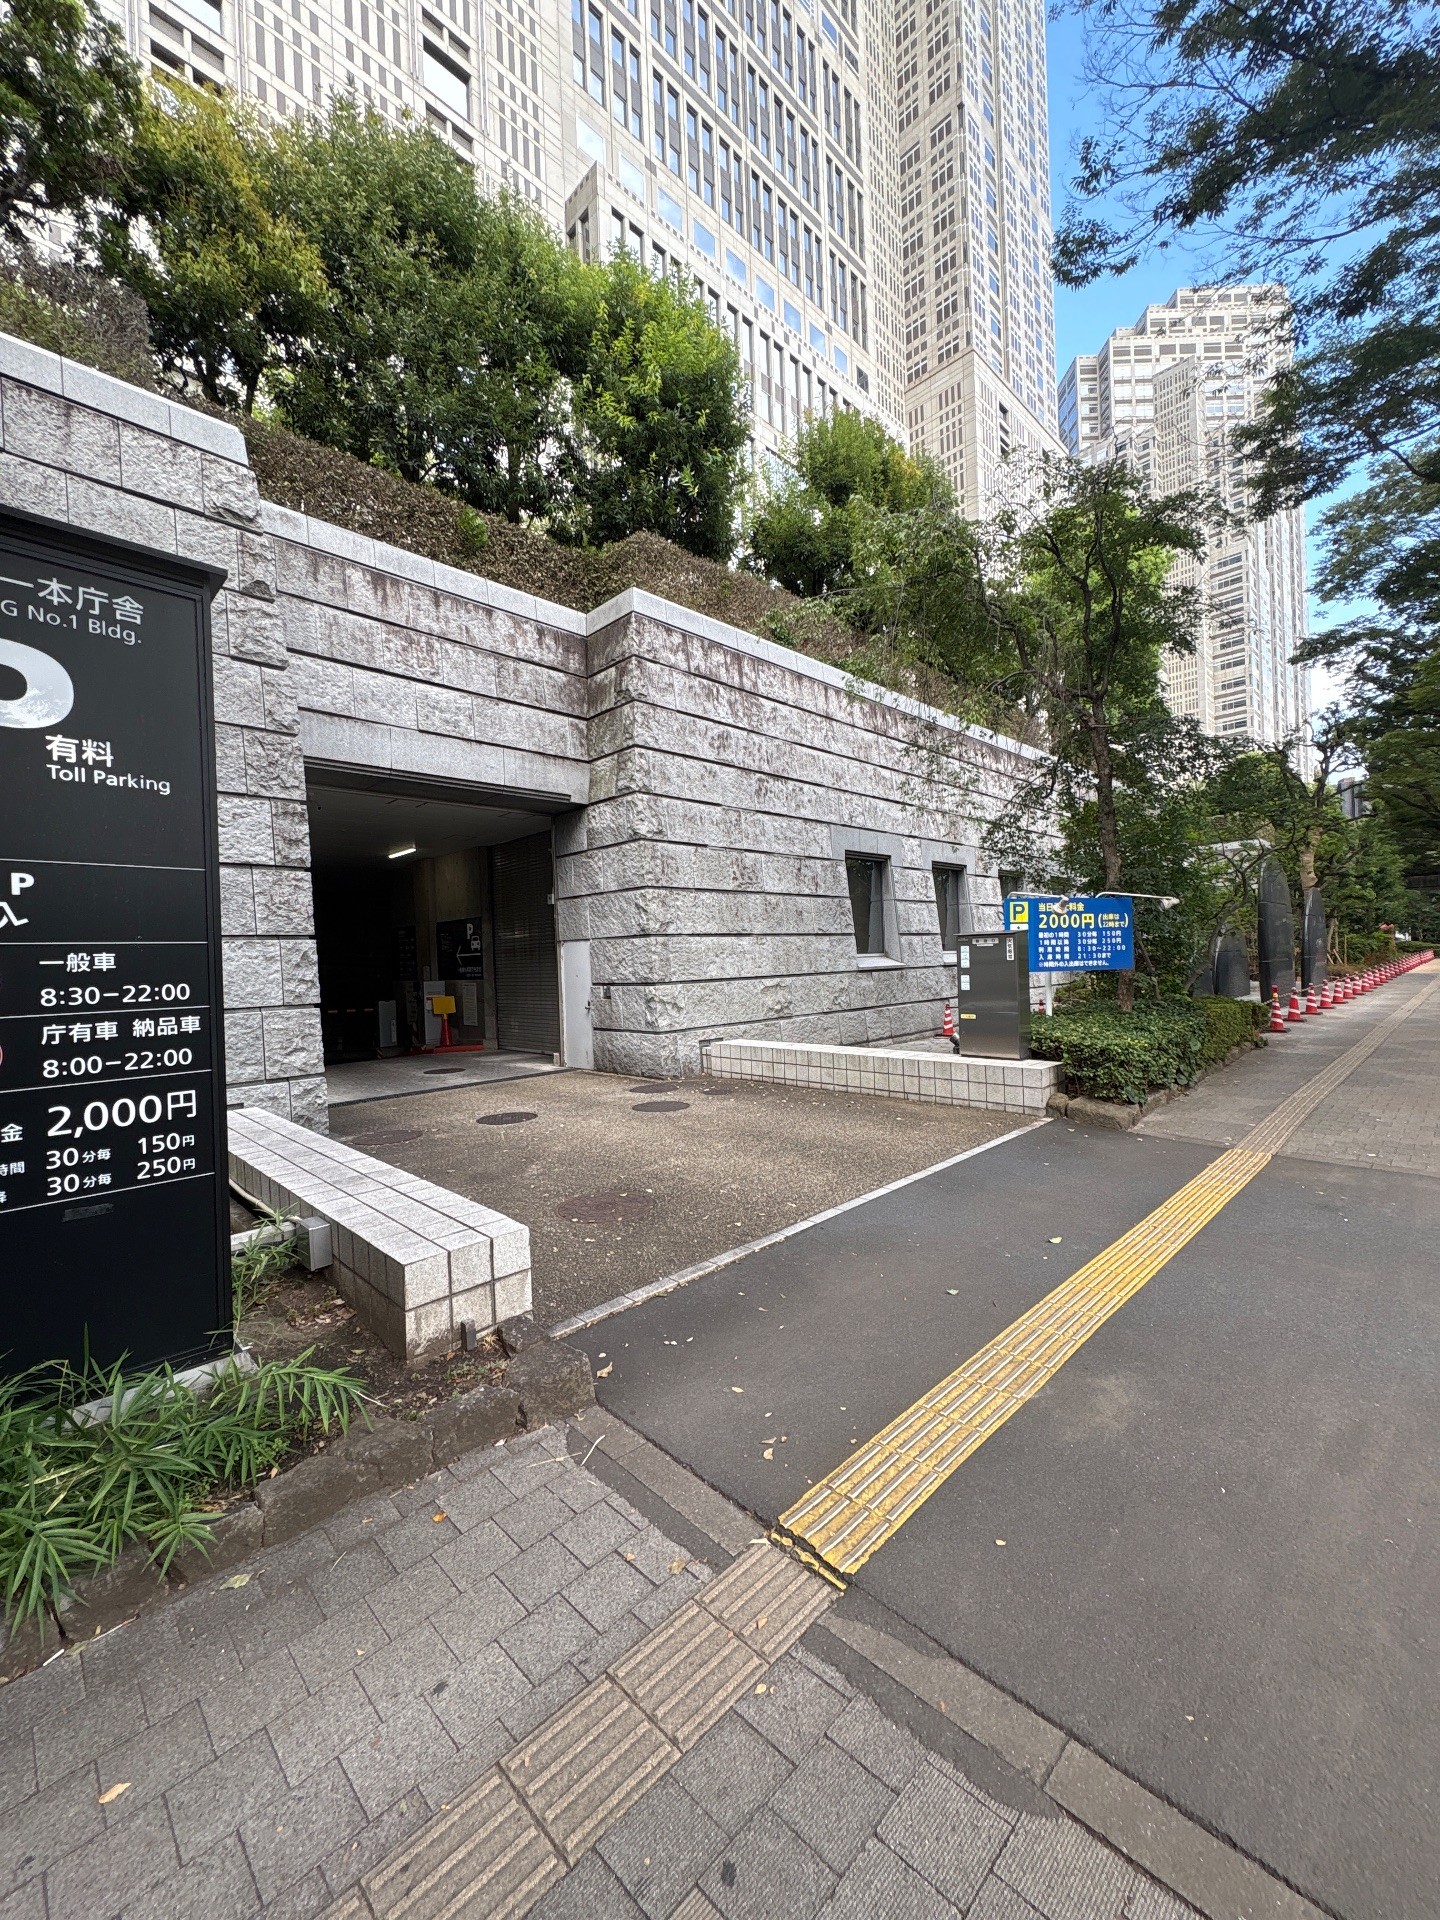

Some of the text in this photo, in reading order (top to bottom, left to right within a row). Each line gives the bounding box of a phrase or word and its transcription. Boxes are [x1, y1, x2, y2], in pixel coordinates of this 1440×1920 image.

[28, 605, 78, 630] No.1
[89, 618, 142, 646] Bldg.
[45, 734, 114, 768] 有料
[46, 764, 171, 796] Toll Parking
[11, 872, 34, 896] P
[1012, 903, 1025, 921] P
[1038, 902, 1085, 912] 当日料金
[1038, 913, 1095, 929] 2000円
[39, 952, 117, 973] 一般車
[41, 1015, 202, 1046] 庁有車 納品車
[1, 1089, 198, 1144] 金 2,000円
[46, 1147, 111, 1170] 30分毎
[137, 1132, 195, 1156] 150円
[46, 1155, 196, 1197] 30分毎 250円
